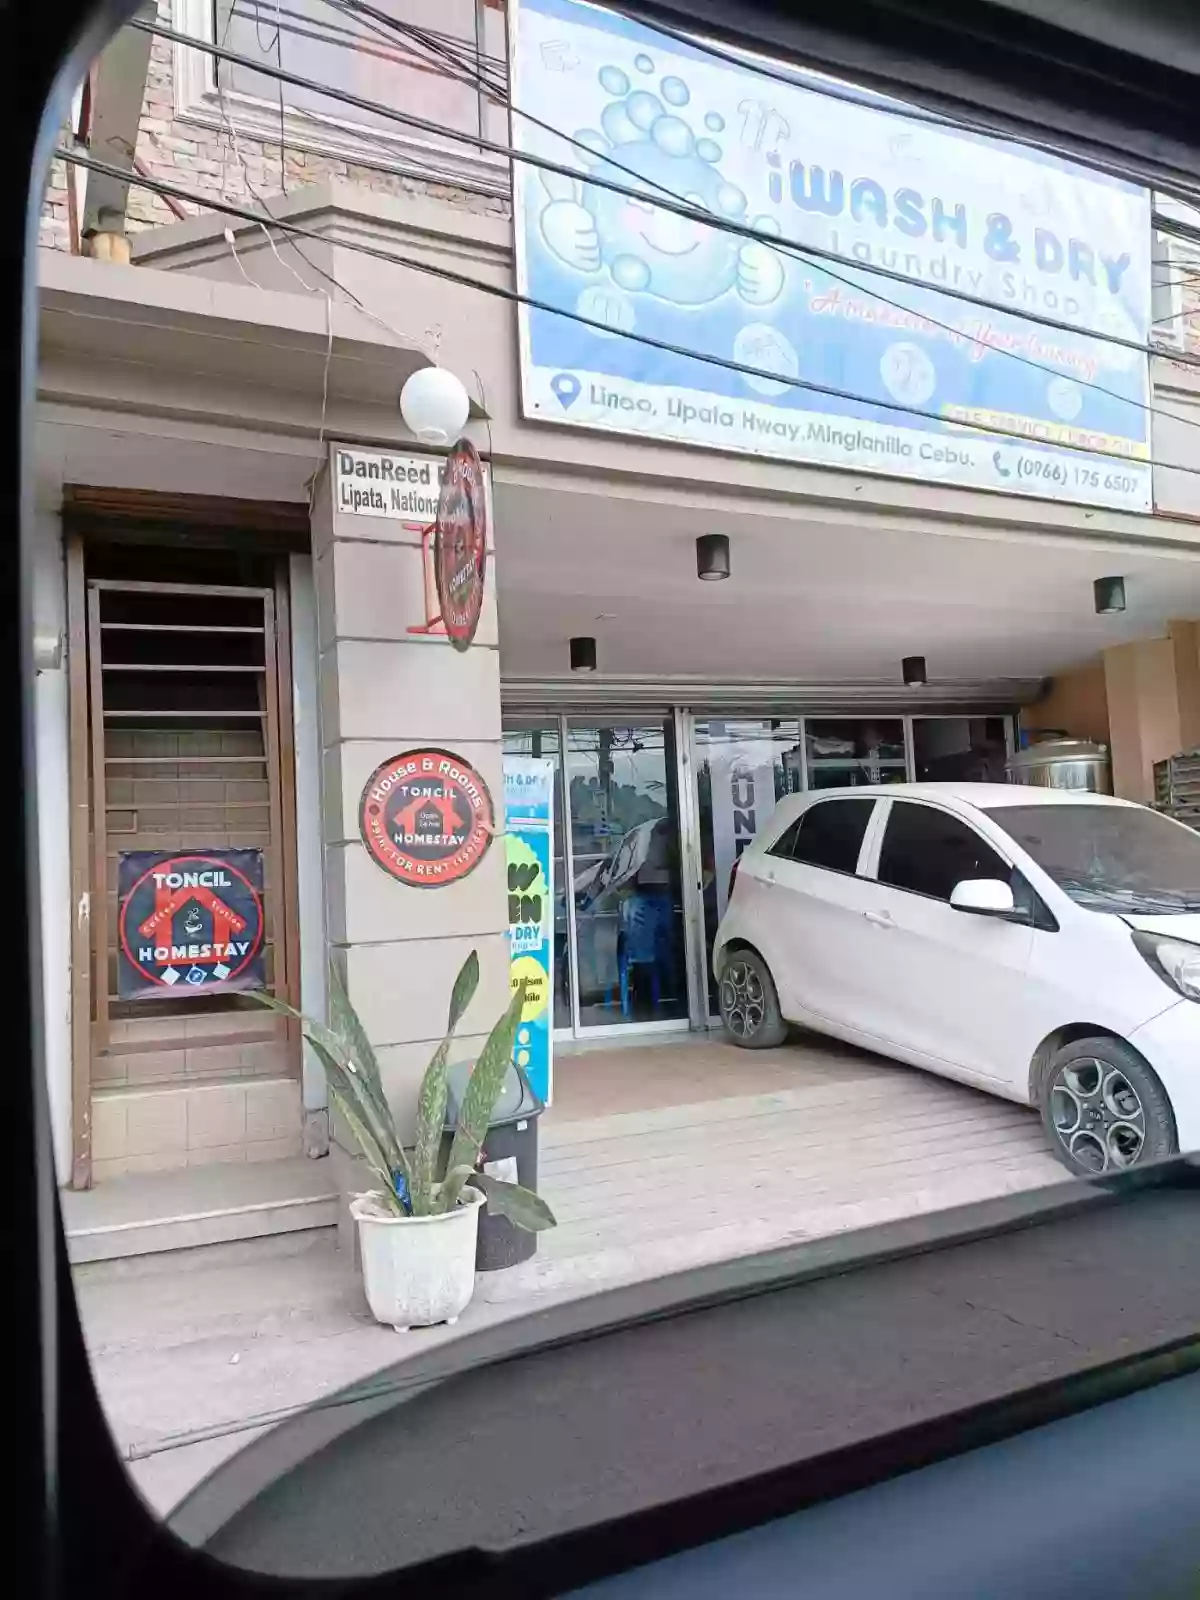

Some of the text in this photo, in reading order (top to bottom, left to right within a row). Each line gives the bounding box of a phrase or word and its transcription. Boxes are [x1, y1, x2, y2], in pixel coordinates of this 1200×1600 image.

[983, 212, 1022, 264] &
[1034, 227, 1131, 295] DRY
[831, 230, 1079, 316] Laundry Shop
[339, 453, 431, 486] DanReed
[1017, 456, 1139, 493] (0966) 175 6507
[341, 482, 439, 515] Lipata, Nationa
[371, 761, 417, 803] House
[439, 759, 485, 809] Rooms
[401, 786, 457, 800] TONCIL
[394, 833, 465, 846] HOMESTAY
[152, 871, 232, 889] TONCIL
[417, 862, 449, 876] RENT
[138, 942, 250, 962] HOMESTAY
